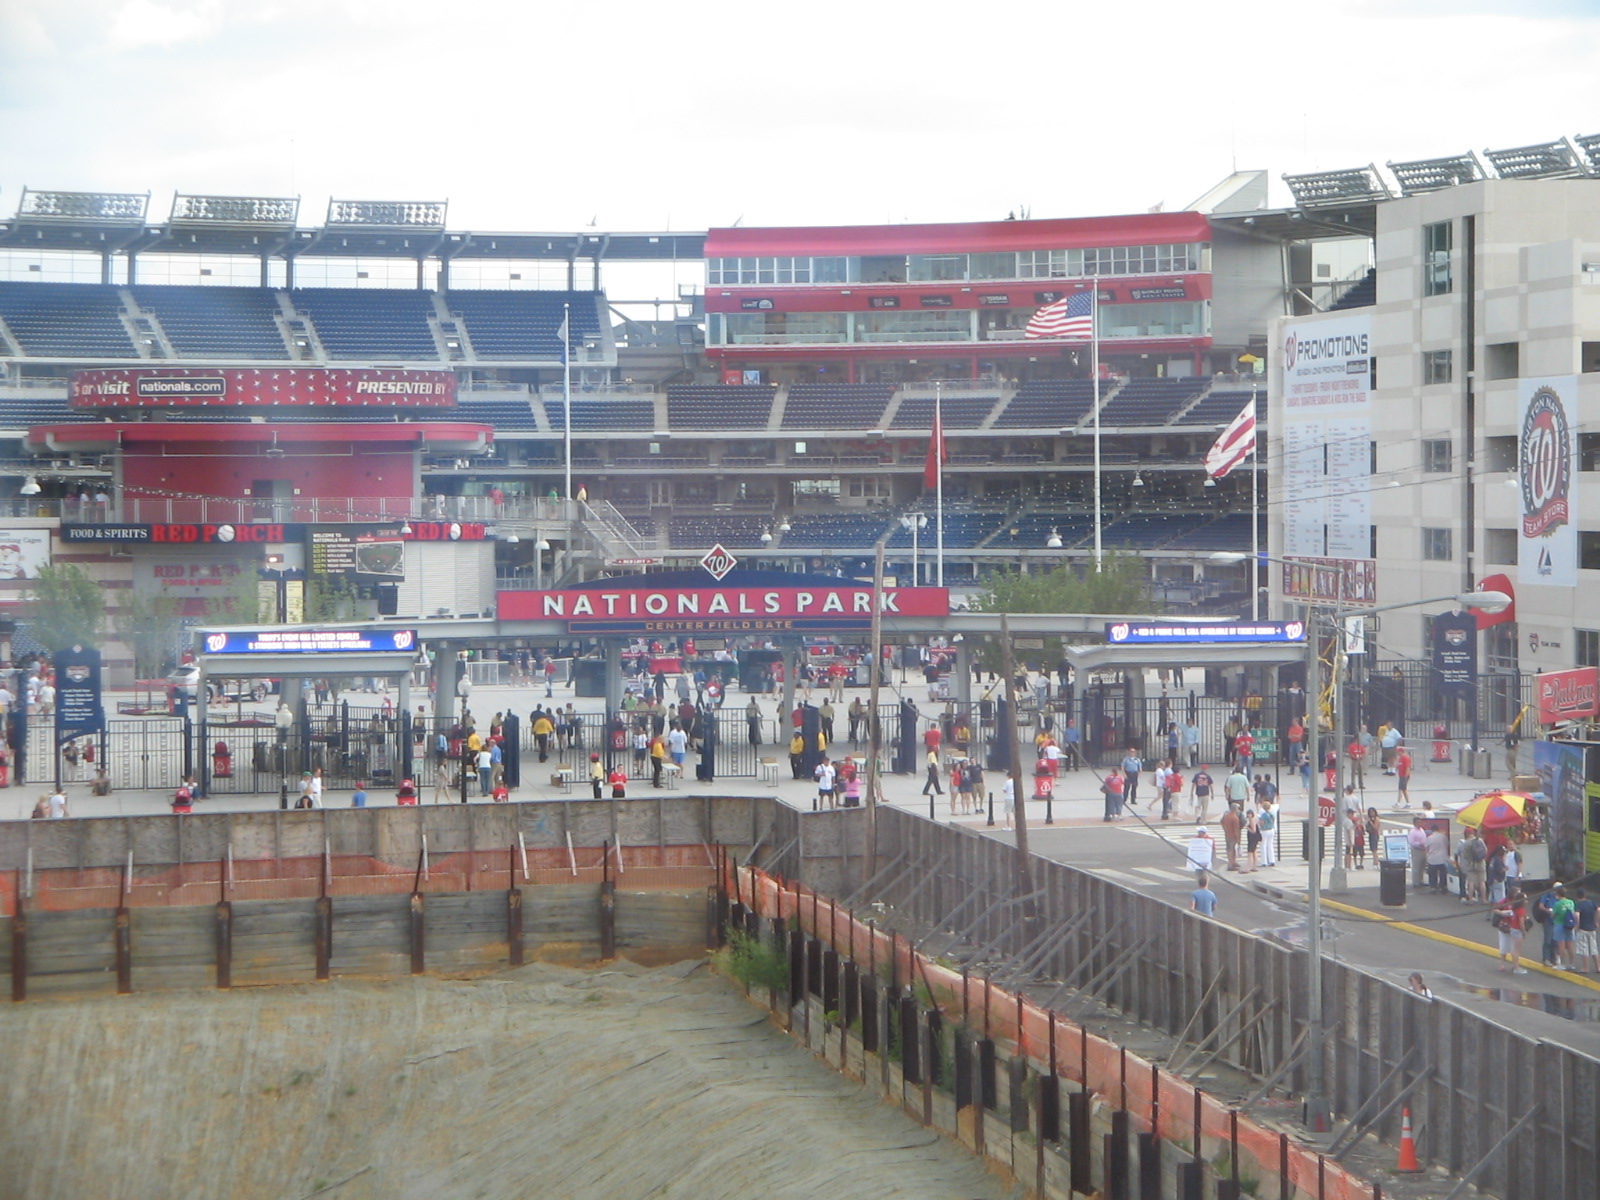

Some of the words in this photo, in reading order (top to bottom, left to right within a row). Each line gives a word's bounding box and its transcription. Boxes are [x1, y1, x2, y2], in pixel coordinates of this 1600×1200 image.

[1297, 333, 1368, 361] PROMOTIONS
[97, 380, 131, 395] visit
[140, 381, 222, 392] nationals.com
[356, 381, 432, 394] PRESENTED
[434, 383, 447, 395] BY
[1525, 518, 1543, 534] TEAM
[1543, 502, 1566, 522] STORE
[70, 529, 94, 538] FOOD
[95, 529, 103, 539] &
[104, 528, 148, 539] SPIRITS
[152, 523, 198, 543] RED
[153, 565, 185, 578] RED
[543, 591, 781, 617] NATIONALS
[797, 589, 901, 614] PARK
[645, 622, 704, 631] CENTER
[708, 621, 752, 630] FIELD
[755, 620, 794, 630] GATE
[1550, 677, 1595, 711] Bullpen
[1318, 806, 1336, 818] TOP
